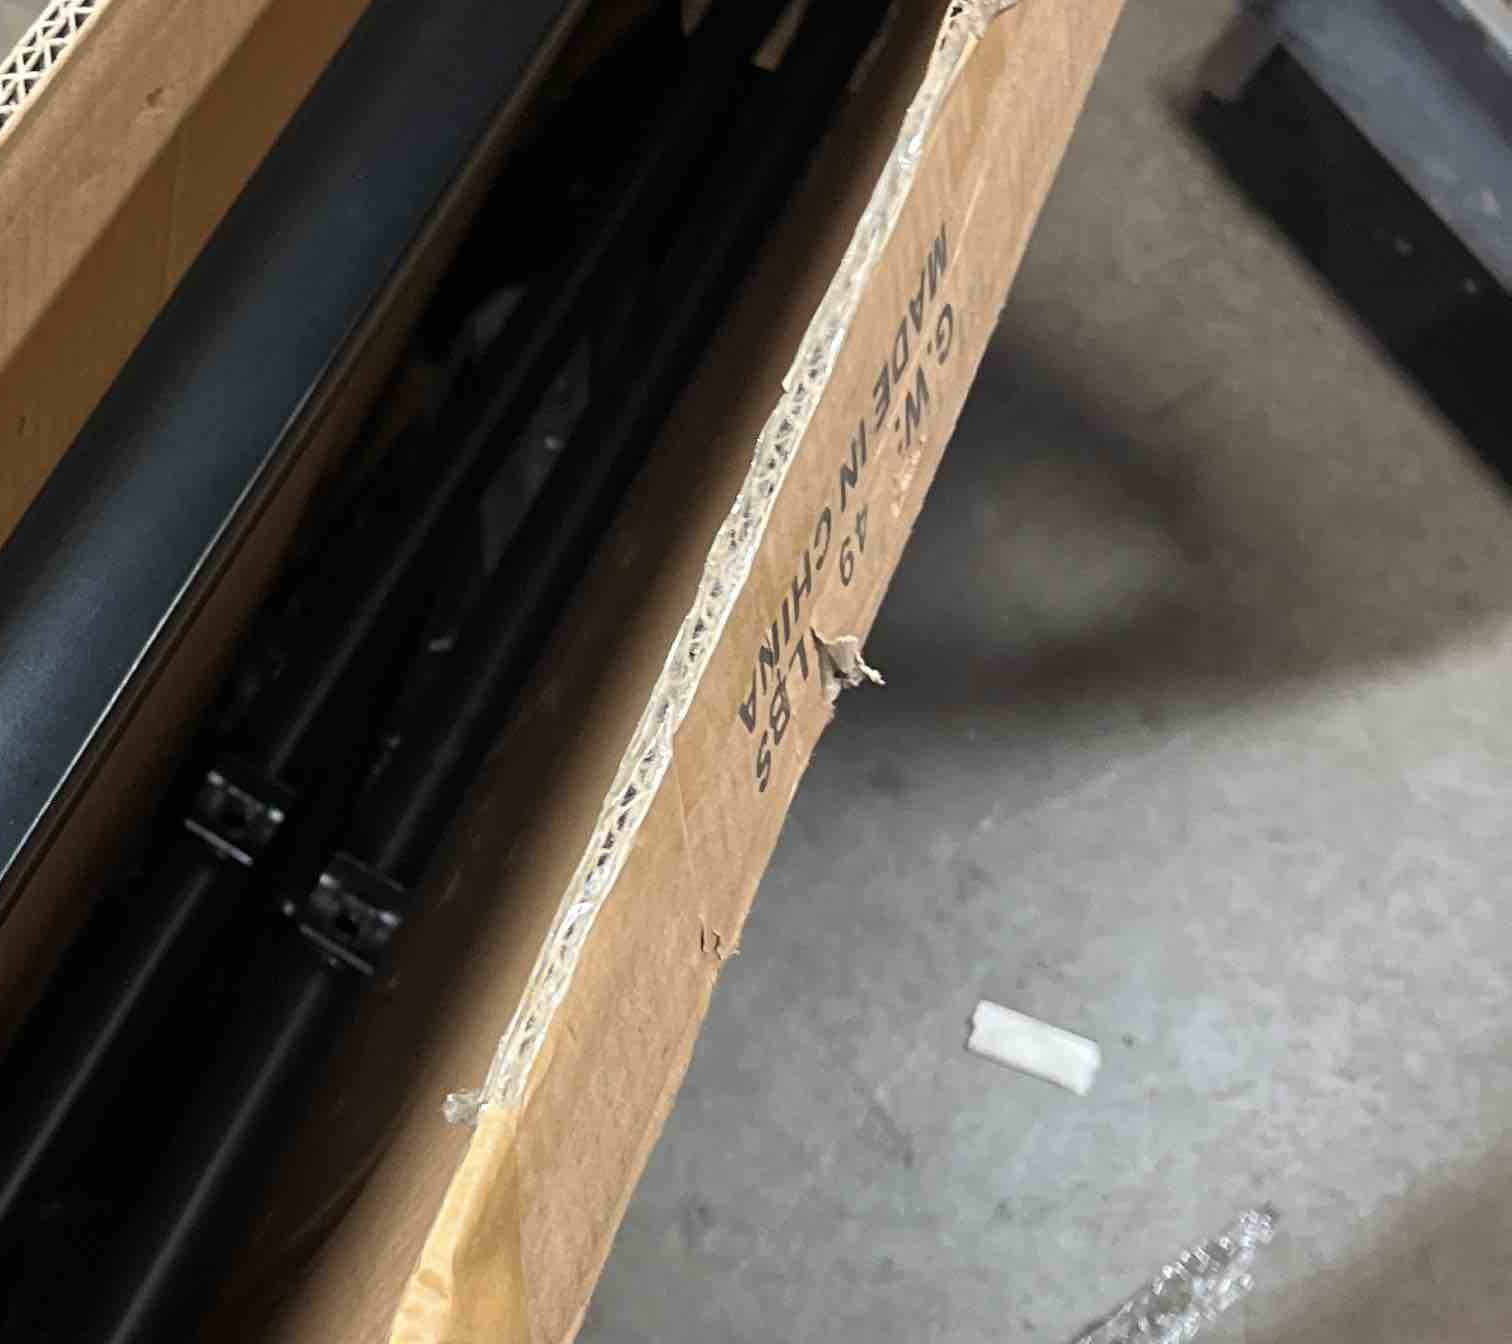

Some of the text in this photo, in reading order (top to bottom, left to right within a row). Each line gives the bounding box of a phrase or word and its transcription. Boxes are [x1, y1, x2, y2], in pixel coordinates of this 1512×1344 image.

[738, 222, 947, 734] MADE IN CHINA
[839, 504, 868, 587] 49
[756, 635, 809, 793] LBS
